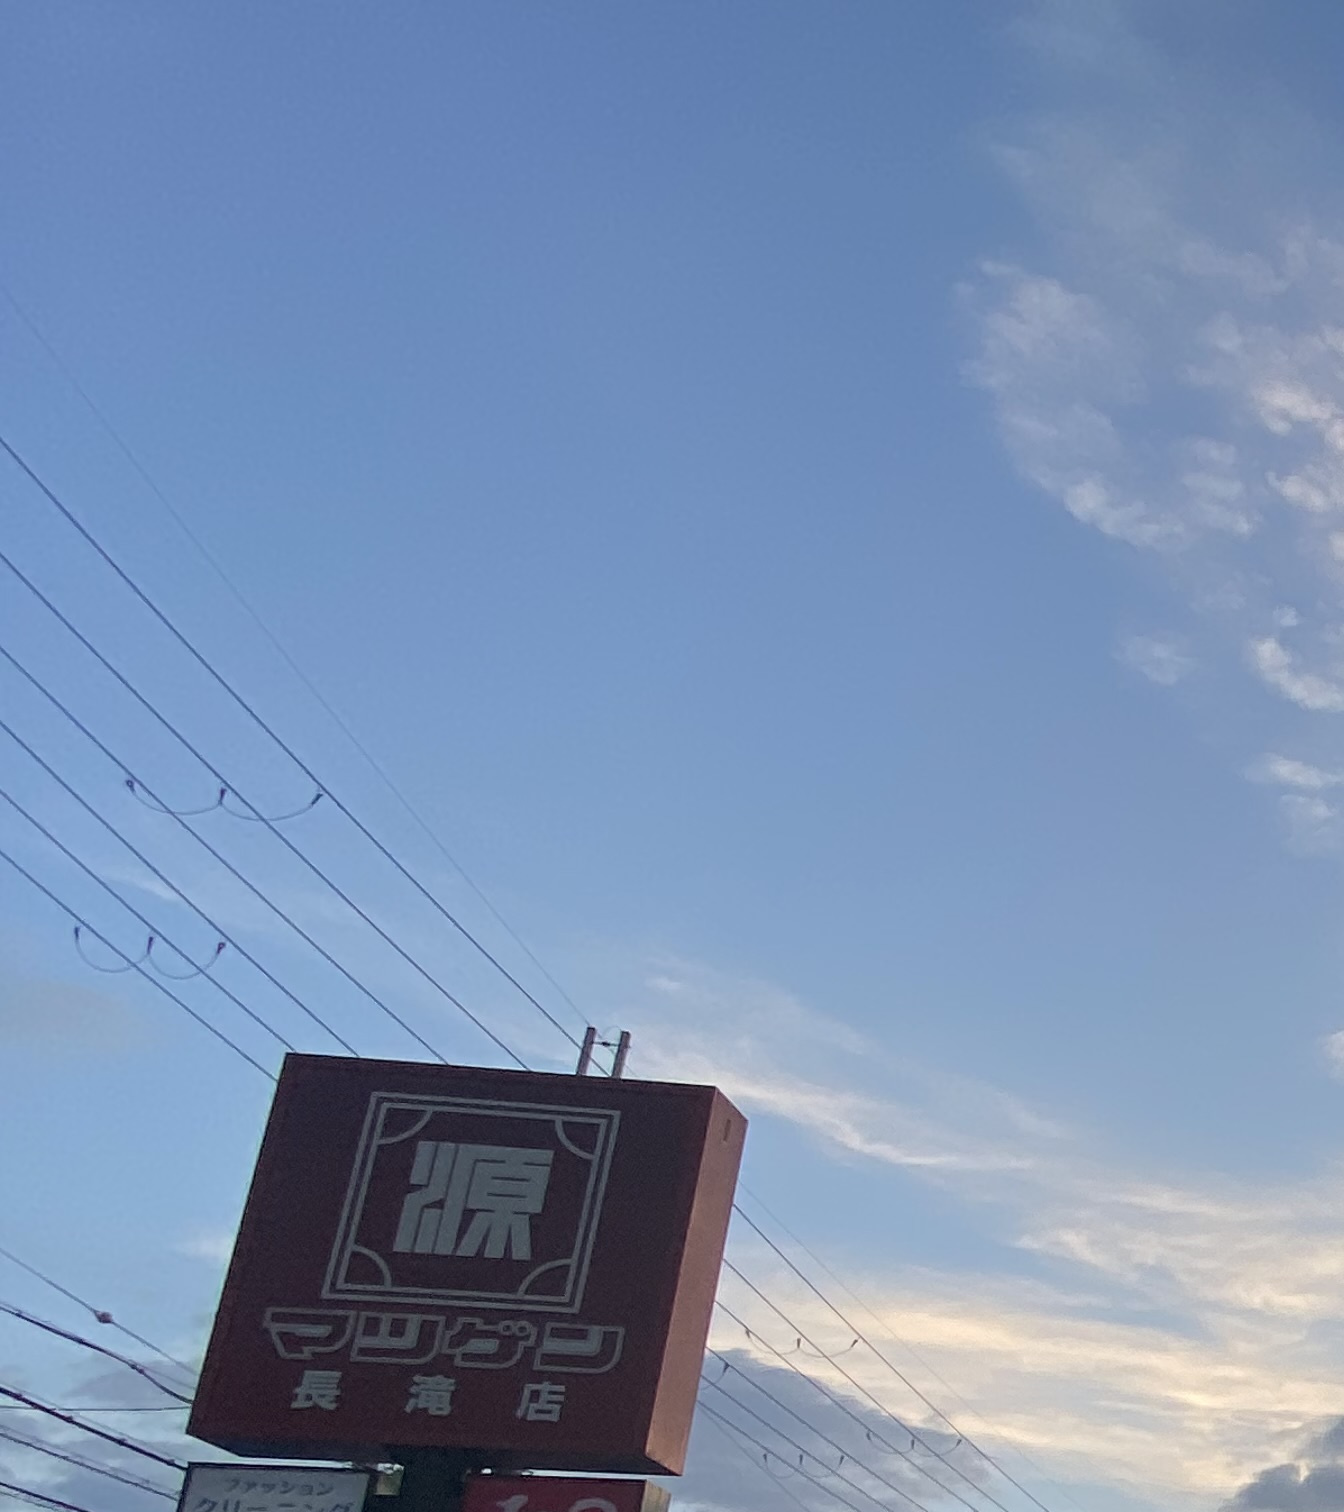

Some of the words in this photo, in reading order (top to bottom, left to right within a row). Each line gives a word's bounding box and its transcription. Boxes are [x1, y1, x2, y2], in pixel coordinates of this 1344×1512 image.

[393, 1140, 556, 1261] 源
[263, 1307, 626, 1374] マツゲン
[289, 1369, 566, 1424] 長滝店
[224, 1477, 335, 1496] ファッション
